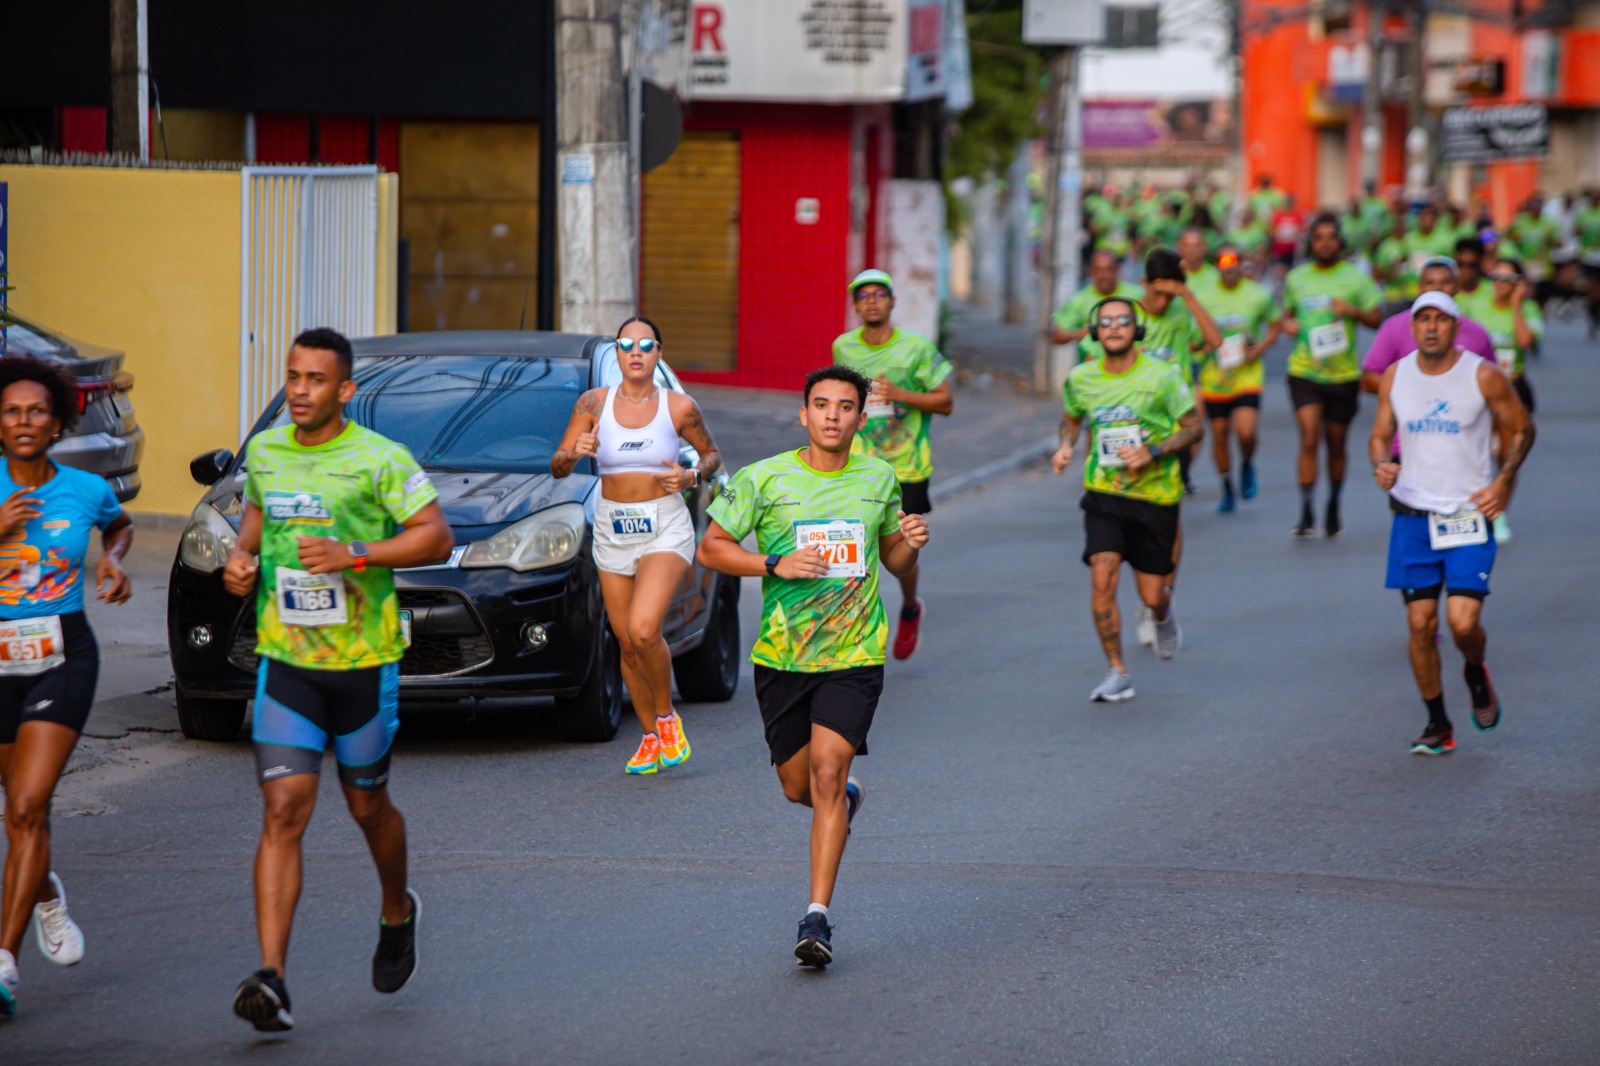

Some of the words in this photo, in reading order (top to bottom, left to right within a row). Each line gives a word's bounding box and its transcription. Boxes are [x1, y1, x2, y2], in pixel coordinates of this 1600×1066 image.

[692, 7, 724, 52] R
[1406, 418, 1461, 433] NATIVOS
[620, 519, 649, 534] 1014
[809, 531, 827, 541] 05k
[291, 590, 333, 610] 1166
[8, 639, 42, 660] 651
